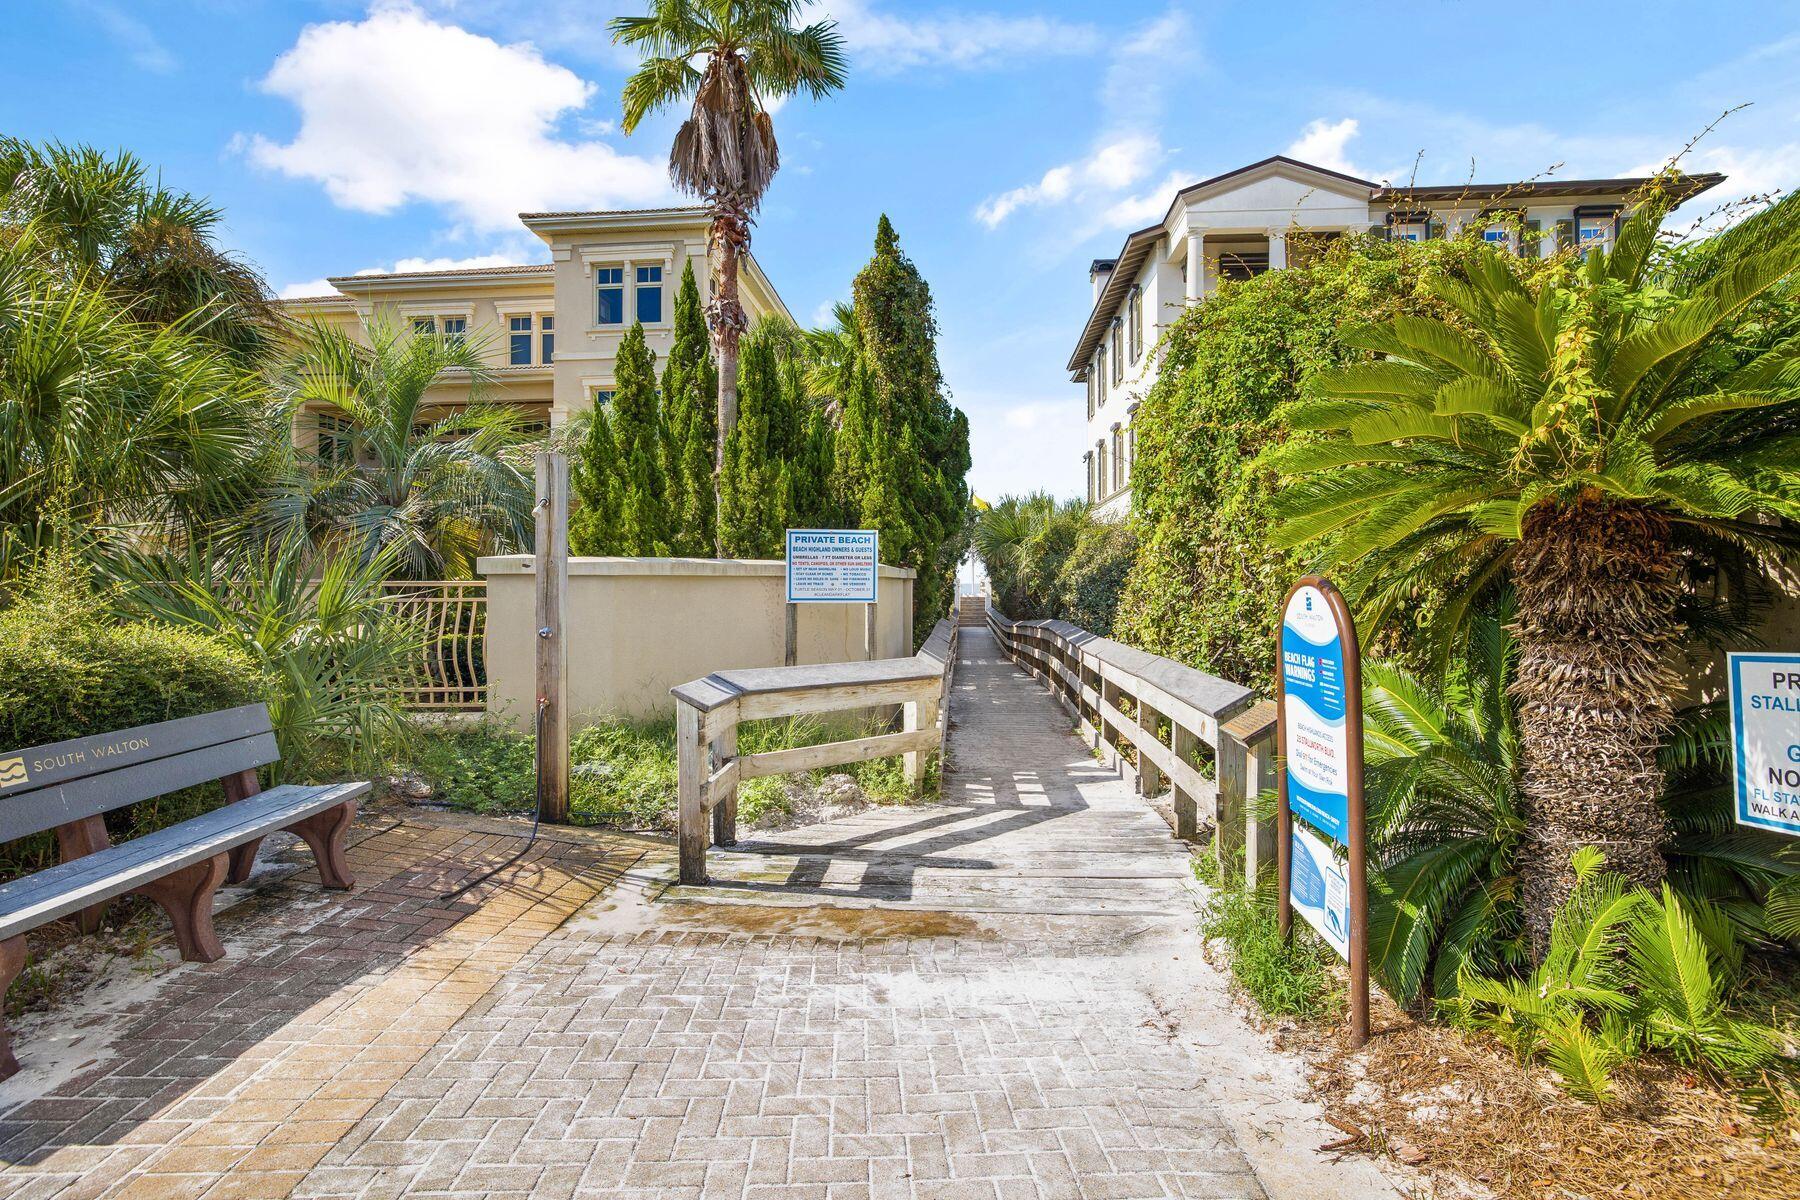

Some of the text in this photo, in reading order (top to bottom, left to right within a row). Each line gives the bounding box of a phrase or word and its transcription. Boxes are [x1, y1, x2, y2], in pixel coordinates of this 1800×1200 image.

[794, 535, 871, 544] PRIVATE BEACH
[1284, 651, 1300, 664] BEACH
[1301, 654, 1315, 668] FLAG
[1284, 663, 1316, 682] WARNINGS
[34, 738, 150, 772] SOUTH WALTON
[1754, 788, 1800, 806] FL STA
[1752, 802, 1788, 818] WALK
